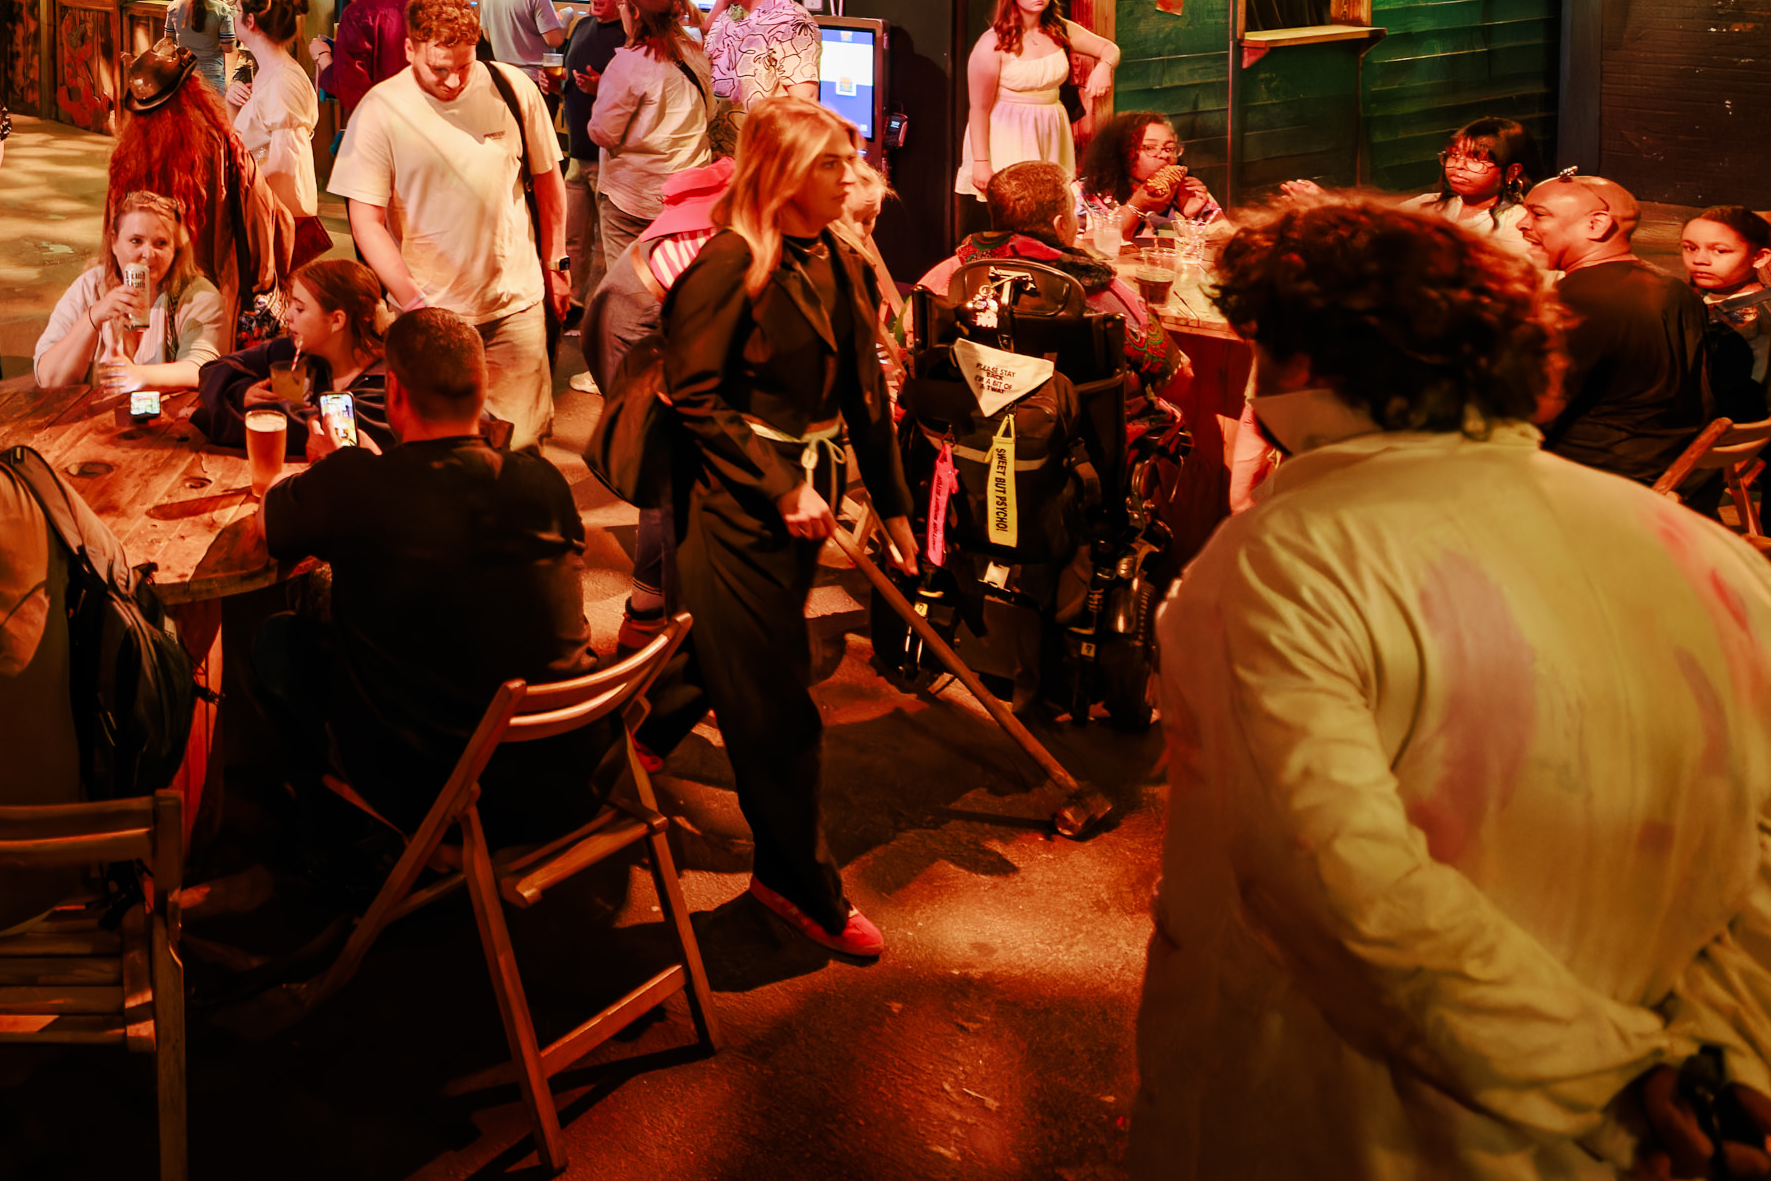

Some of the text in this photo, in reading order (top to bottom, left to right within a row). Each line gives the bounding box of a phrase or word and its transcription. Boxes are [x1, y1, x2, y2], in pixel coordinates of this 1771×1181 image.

[976, 363, 1016, 377] PLEASE STAY
[986, 372, 1004, 381] BACK
[994, 448, 1009, 532] SWEET BUT PSYCHO!
